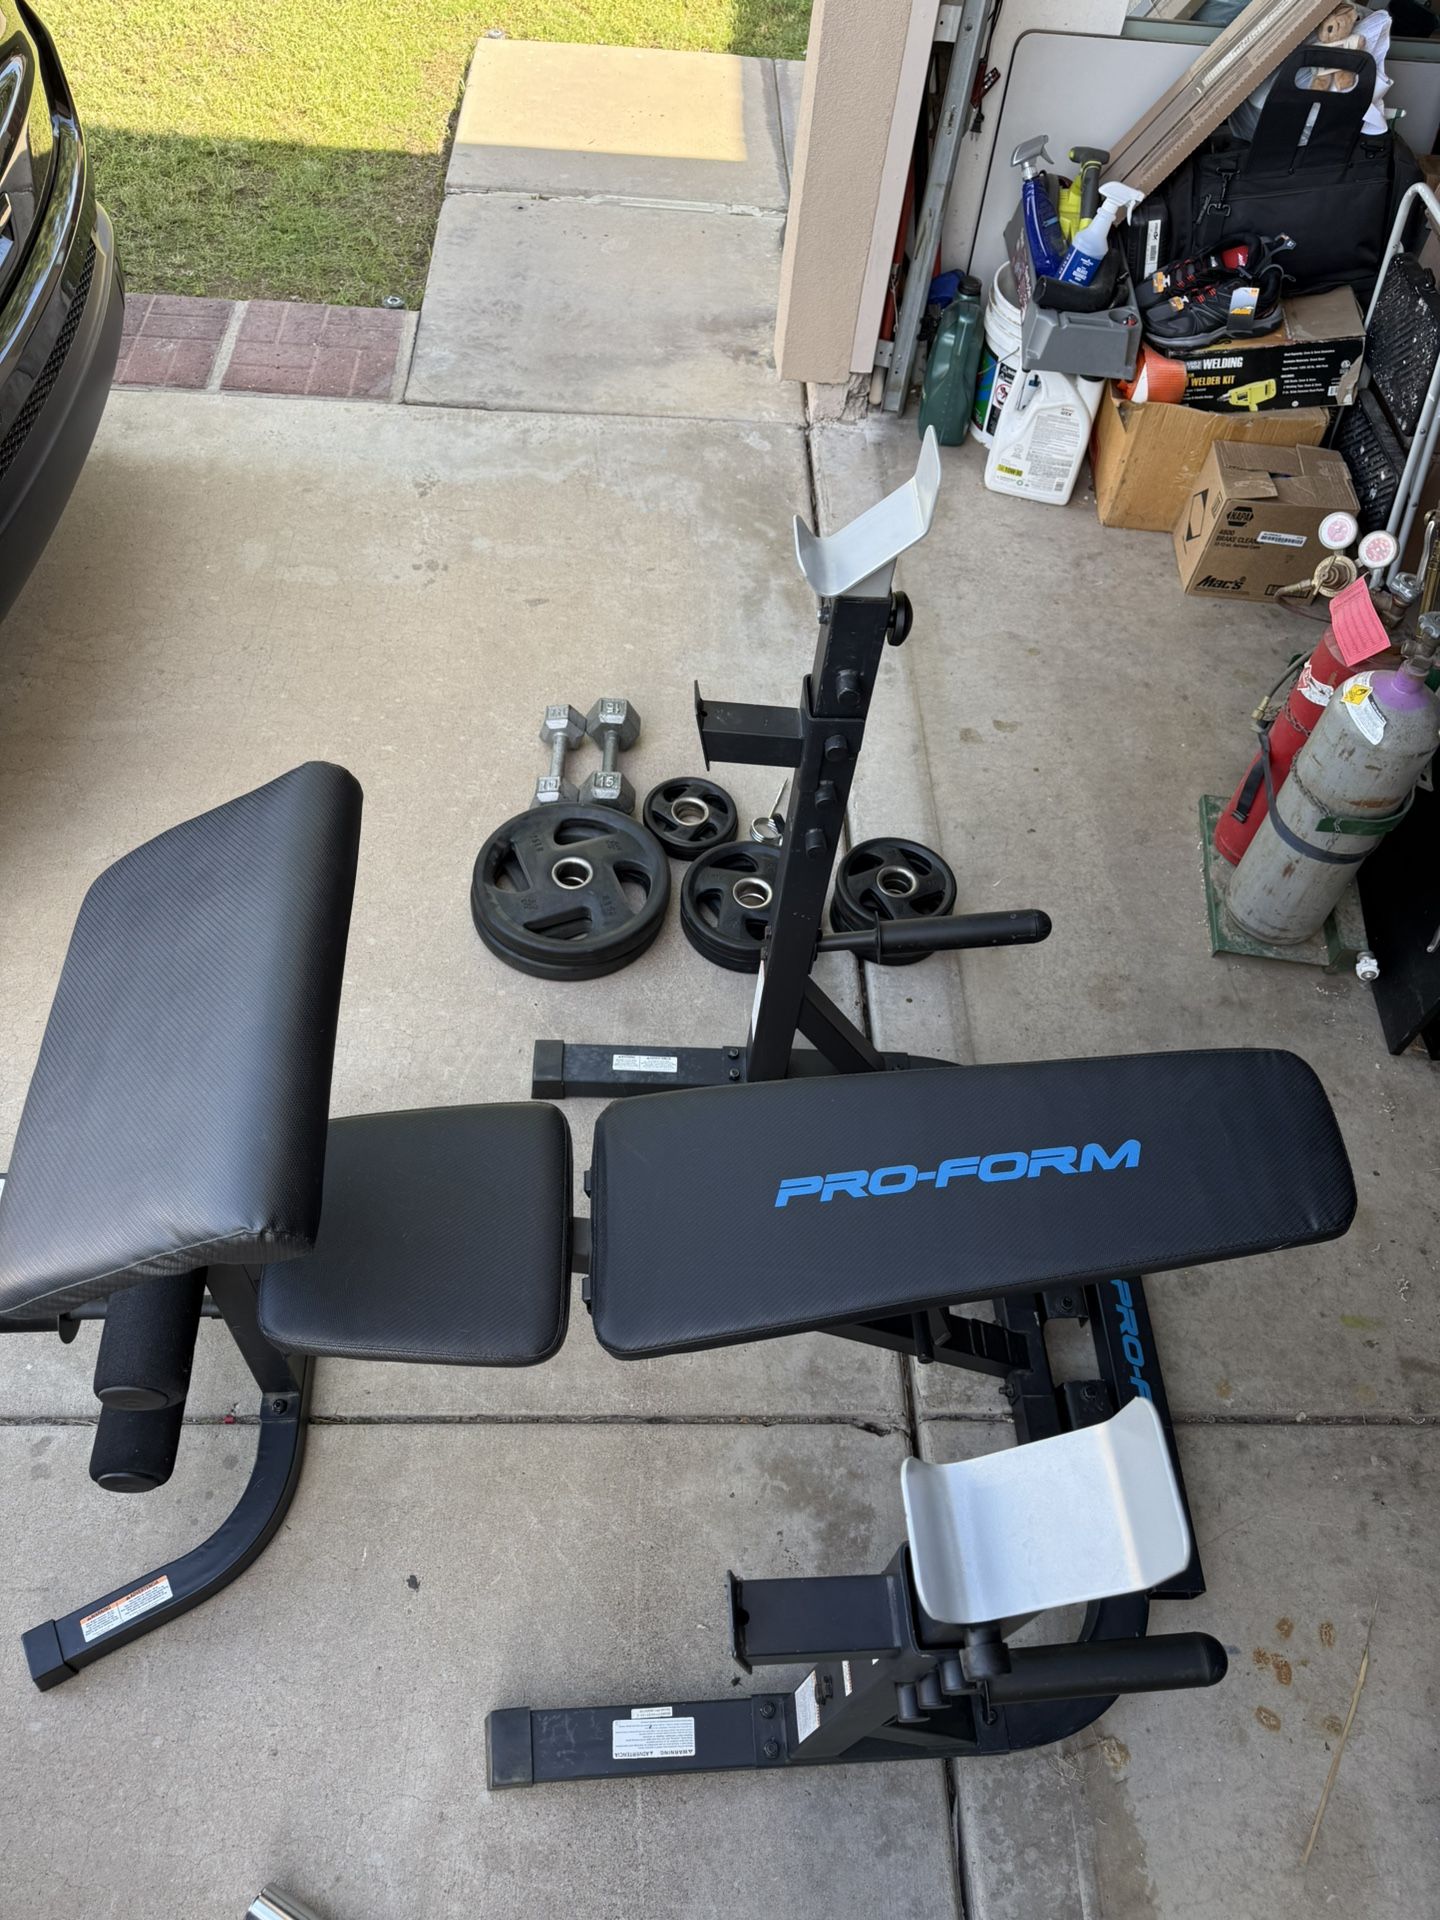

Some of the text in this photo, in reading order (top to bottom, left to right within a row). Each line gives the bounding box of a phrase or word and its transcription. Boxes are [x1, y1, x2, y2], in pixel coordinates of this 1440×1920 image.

[1202, 356, 1244, 370] WELDING
[1190, 374, 1236, 387] WELDER KIT
[1196, 575, 1244, 590] Mac's
[599, 776, 614, 787] 15
[775, 1139, 1141, 1207] PRO-FORM
[1110, 1279, 1152, 1402] PRO-F
